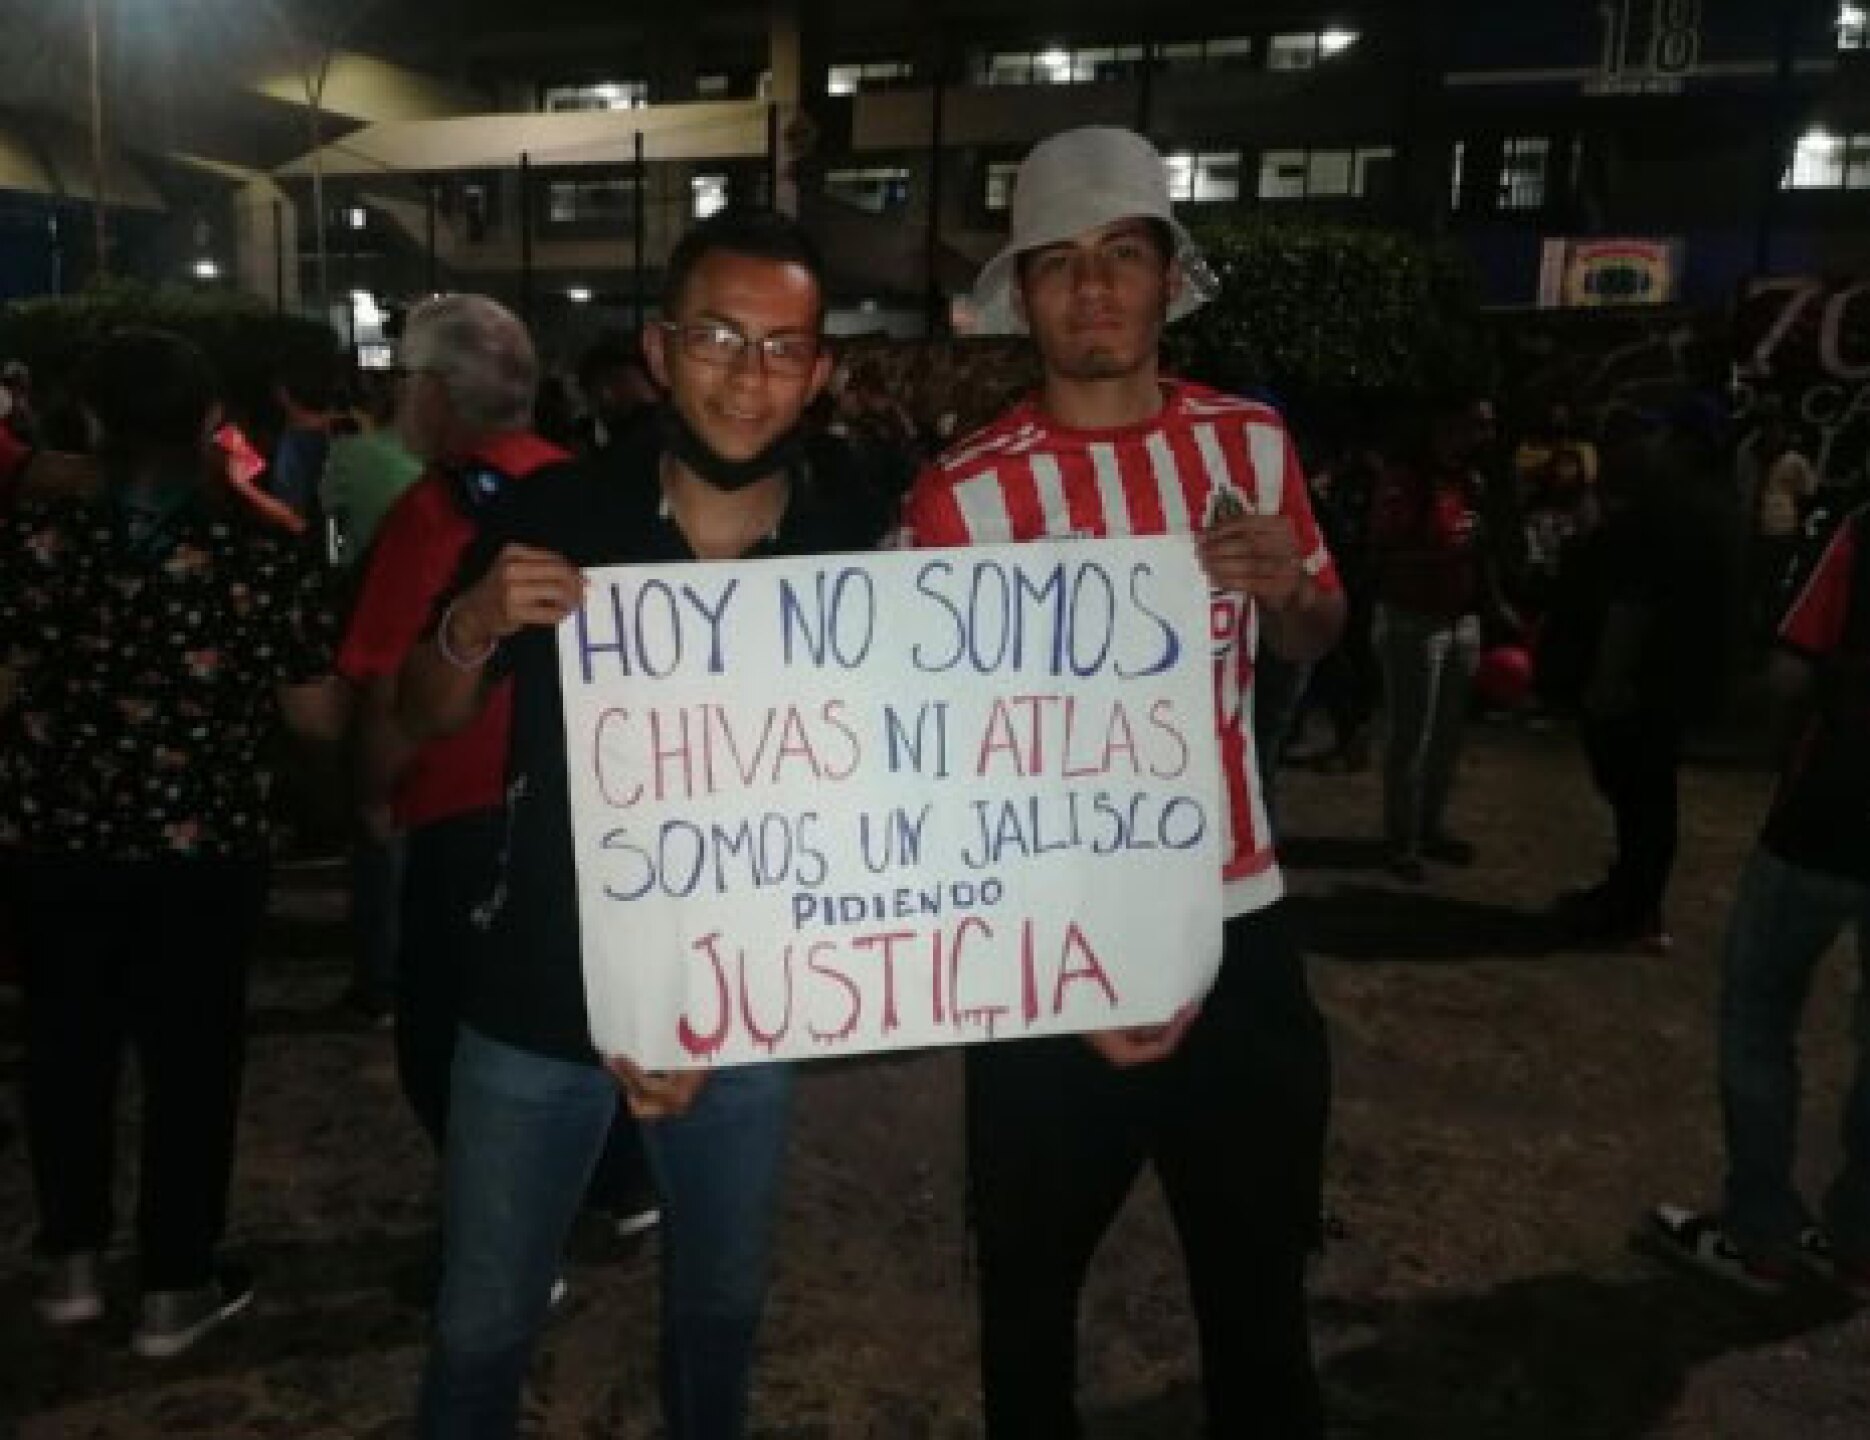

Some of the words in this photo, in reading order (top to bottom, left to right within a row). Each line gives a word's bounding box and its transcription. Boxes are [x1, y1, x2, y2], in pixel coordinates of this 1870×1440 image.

[576, 577, 741, 685] HOY
[779, 566, 877, 670] NO
[911, 559, 1183, 681] SOMOS
[594, 699, 862, 808] CHIVAS
[884, 700, 950, 780] NI
[976, 695, 1190, 779] ATLAS
[600, 811, 829, 902] SOMOS
[860, 803, 933, 874] UN
[960, 791, 1207, 870] JALISCO
[791, 878, 1004, 931] PIDIENDO
[675, 916, 1119, 1056] JUSTICIA
